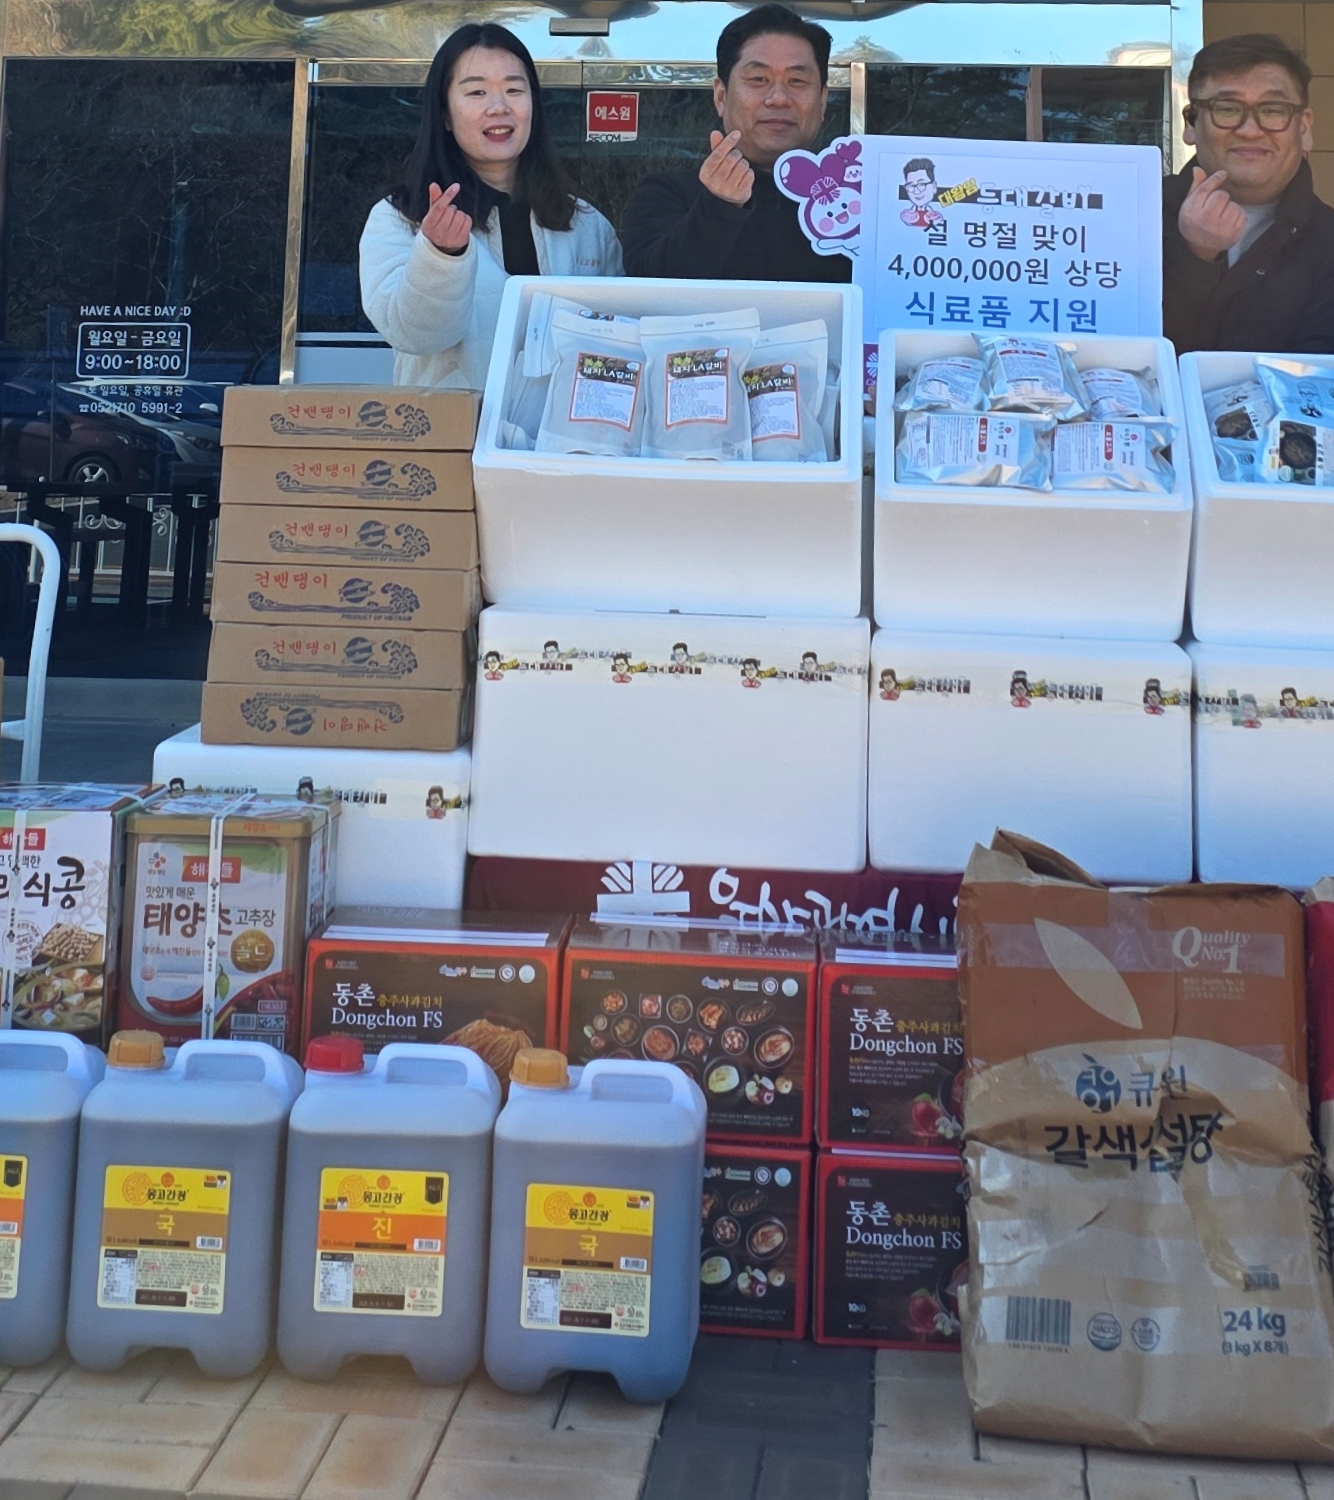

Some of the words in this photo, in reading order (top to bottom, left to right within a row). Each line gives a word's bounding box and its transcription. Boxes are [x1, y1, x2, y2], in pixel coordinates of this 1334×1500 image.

[595, 106, 630, 120] 에스원
[976, 182, 1093, 219] 등대갈비
[923, 220, 948, 247] 설
[964, 221, 1017, 250] 명절
[1033, 225, 1086, 253] 맞이
[888, 254, 1050, 286] 4,000,000원
[1065, 260, 1122, 288] 상당
[80, 306, 111, 316] HAVE
[114, 306, 122, 316] A
[125, 306, 151, 316] NICE
[154, 306, 177, 316] DAY
[905, 292, 1012, 329] 식료품
[1029, 297, 1098, 334] 지원
[88, 330, 127, 346] 월요일
[141, 330, 181, 347] 금요일
[134, 386, 161, 397] 공휴일
[164, 386, 183, 397] 휴관
[288, 405, 351, 420] 건밴댕이
[293, 463, 355, 478] 건밴댕이
[145, 886, 174, 899] 맛있게
[176, 886, 195, 900] 매운
[235, 908, 276, 927] 고추장
[1172, 926, 1251, 968] Quality
[1201, 944, 1242, 974] No.1
[333, 983, 375, 1007] 동촌
[377, 995, 443, 1009] 충주사과김치
[331, 1007, 417, 1030] Dongchon
[423, 1011, 443, 1028] FS
[850, 1008, 894, 1033] 동촌
[849, 1033, 937, 1056] Dongchon
[943, 1037, 963, 1055] FS
[1127, 1064, 1187, 1108] 큐원
[846, 1200, 891, 1226] 동촌
[156, 1214, 175, 1237] 국
[372, 1217, 392, 1241] 진
[578, 1234, 598, 1257] 국
[846, 1226, 935, 1250] Dongchon
[941, 1231, 962, 1250] FS
[1223, 1307, 1254, 1332] 24
